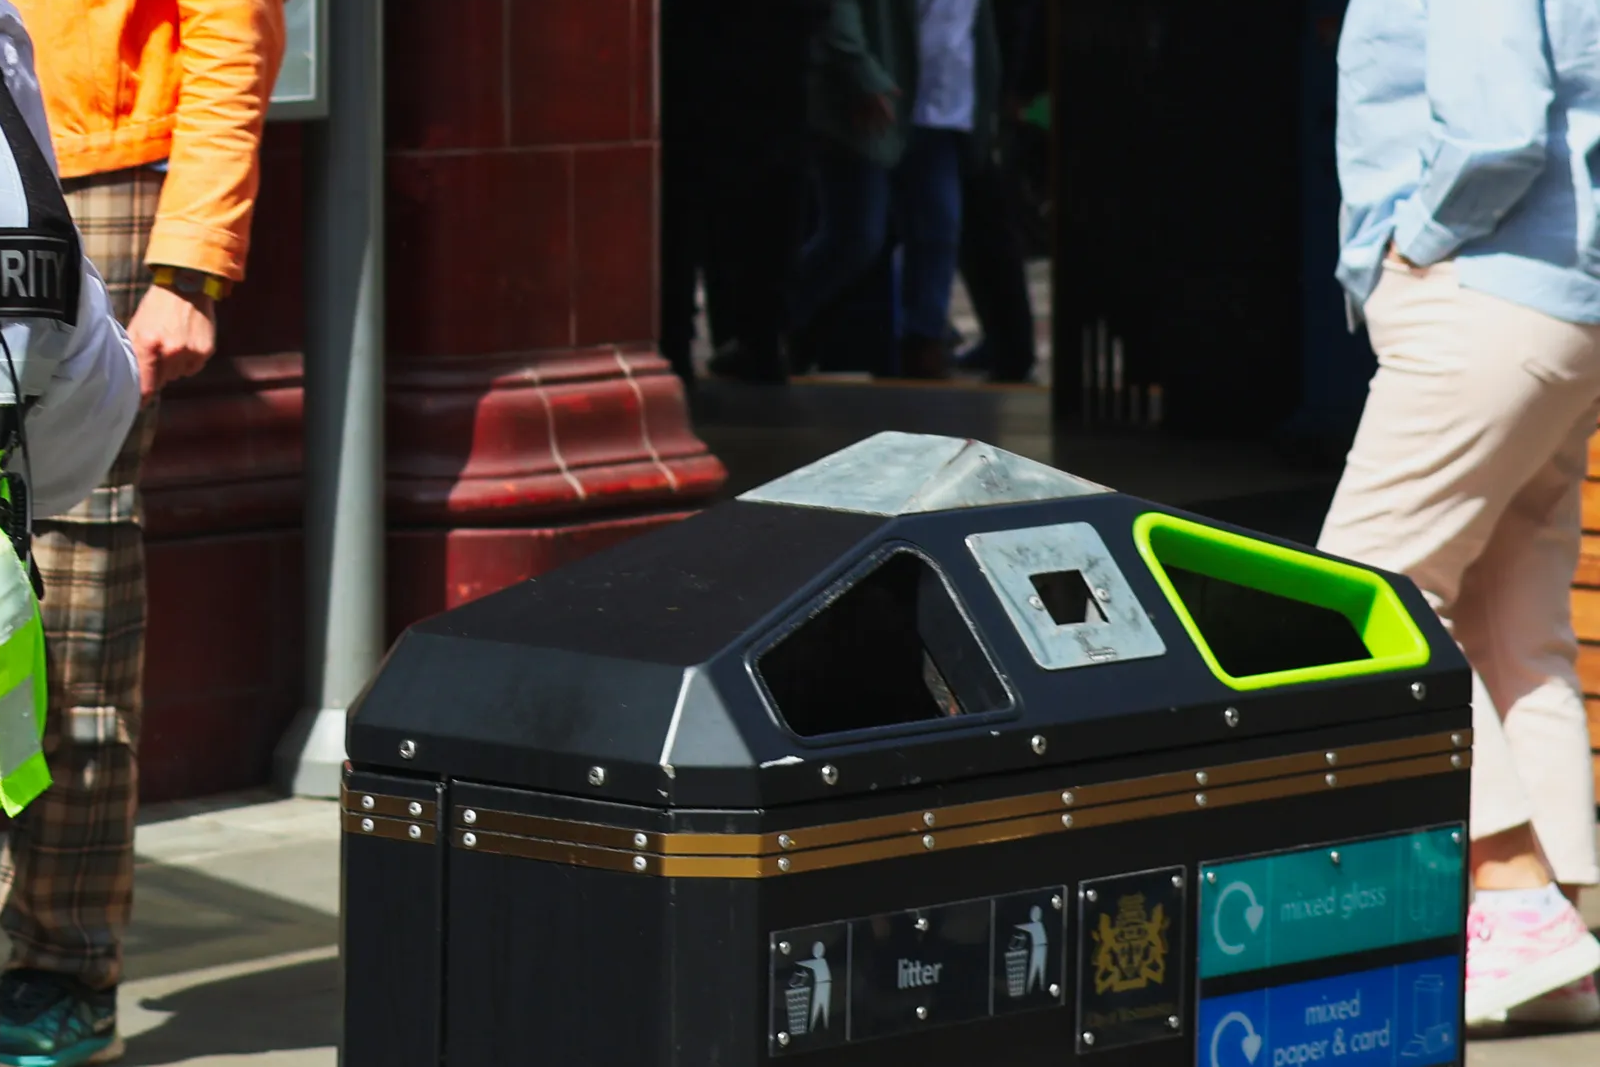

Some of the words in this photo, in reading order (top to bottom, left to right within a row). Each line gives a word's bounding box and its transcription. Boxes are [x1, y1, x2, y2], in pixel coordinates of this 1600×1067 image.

[1280, 886, 1335, 921] mixed
[1340, 881, 1387, 920] glass
[897, 958, 943, 989] litter
[1304, 989, 1360, 1026] mixed
[1273, 1038, 1329, 1067] paper
[1332, 1027, 1347, 1056] &
[1351, 1018, 1391, 1048] card
